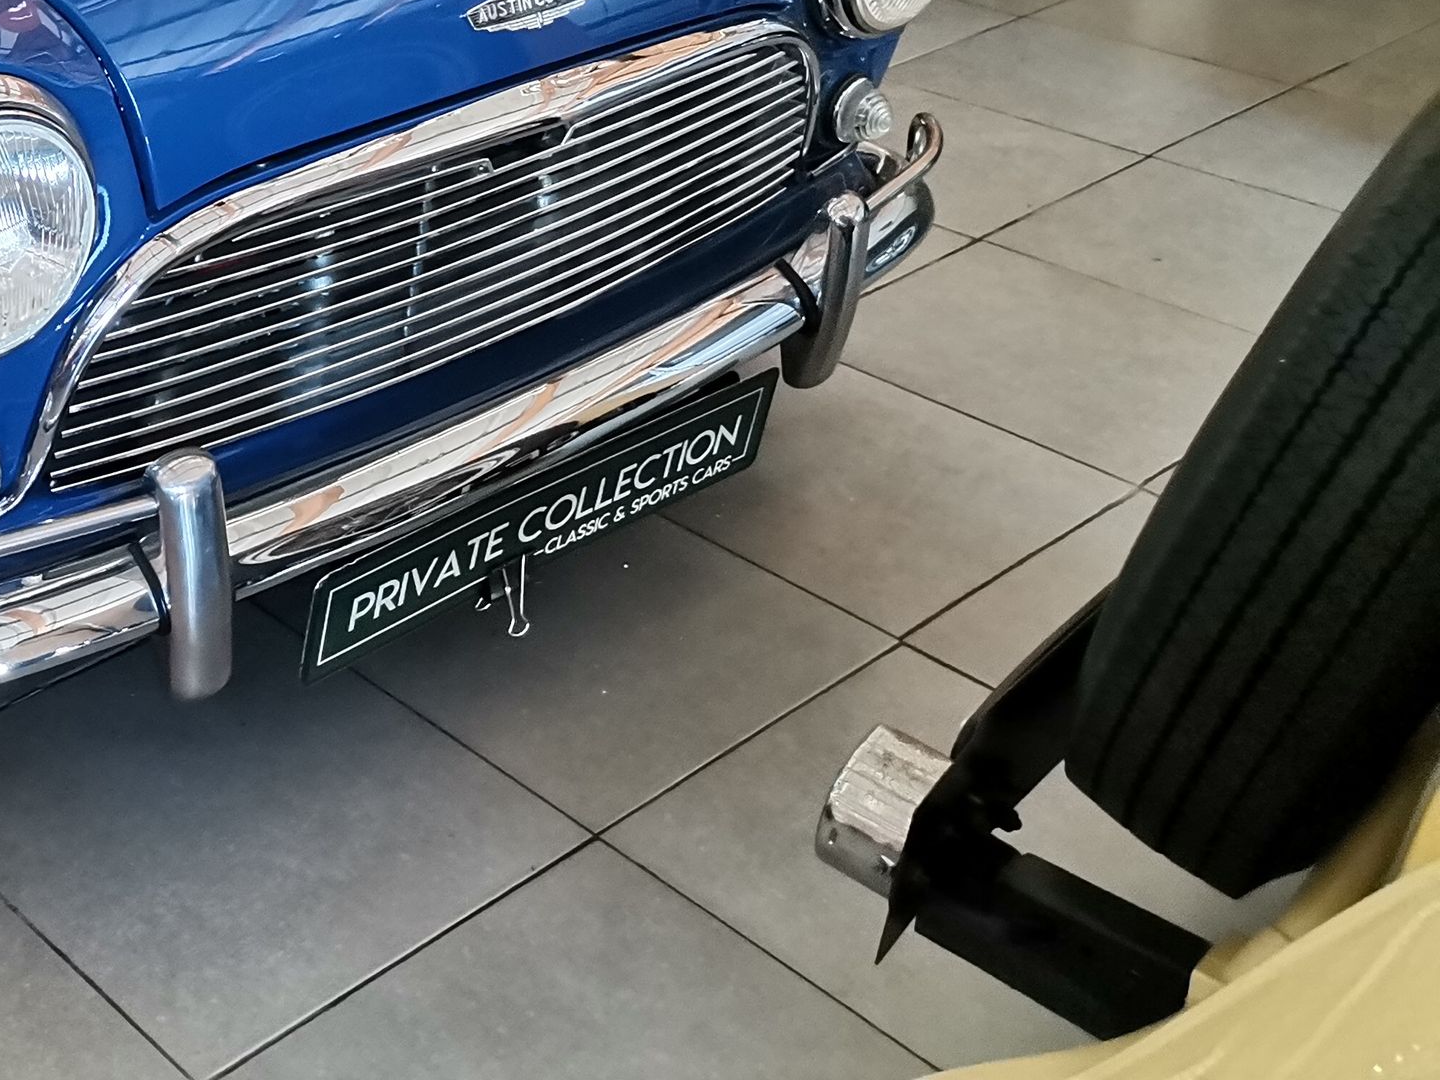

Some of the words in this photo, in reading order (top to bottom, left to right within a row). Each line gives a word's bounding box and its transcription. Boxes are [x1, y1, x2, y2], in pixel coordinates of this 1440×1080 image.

[347, 522, 509, 632] PRIVATE
[517, 415, 743, 544] COLLECTION
[544, 513, 609, 555] CLASSIC
[613, 506, 625, 522] &
[629, 475, 688, 514] SPORTS
[691, 455, 732, 485] CARS
